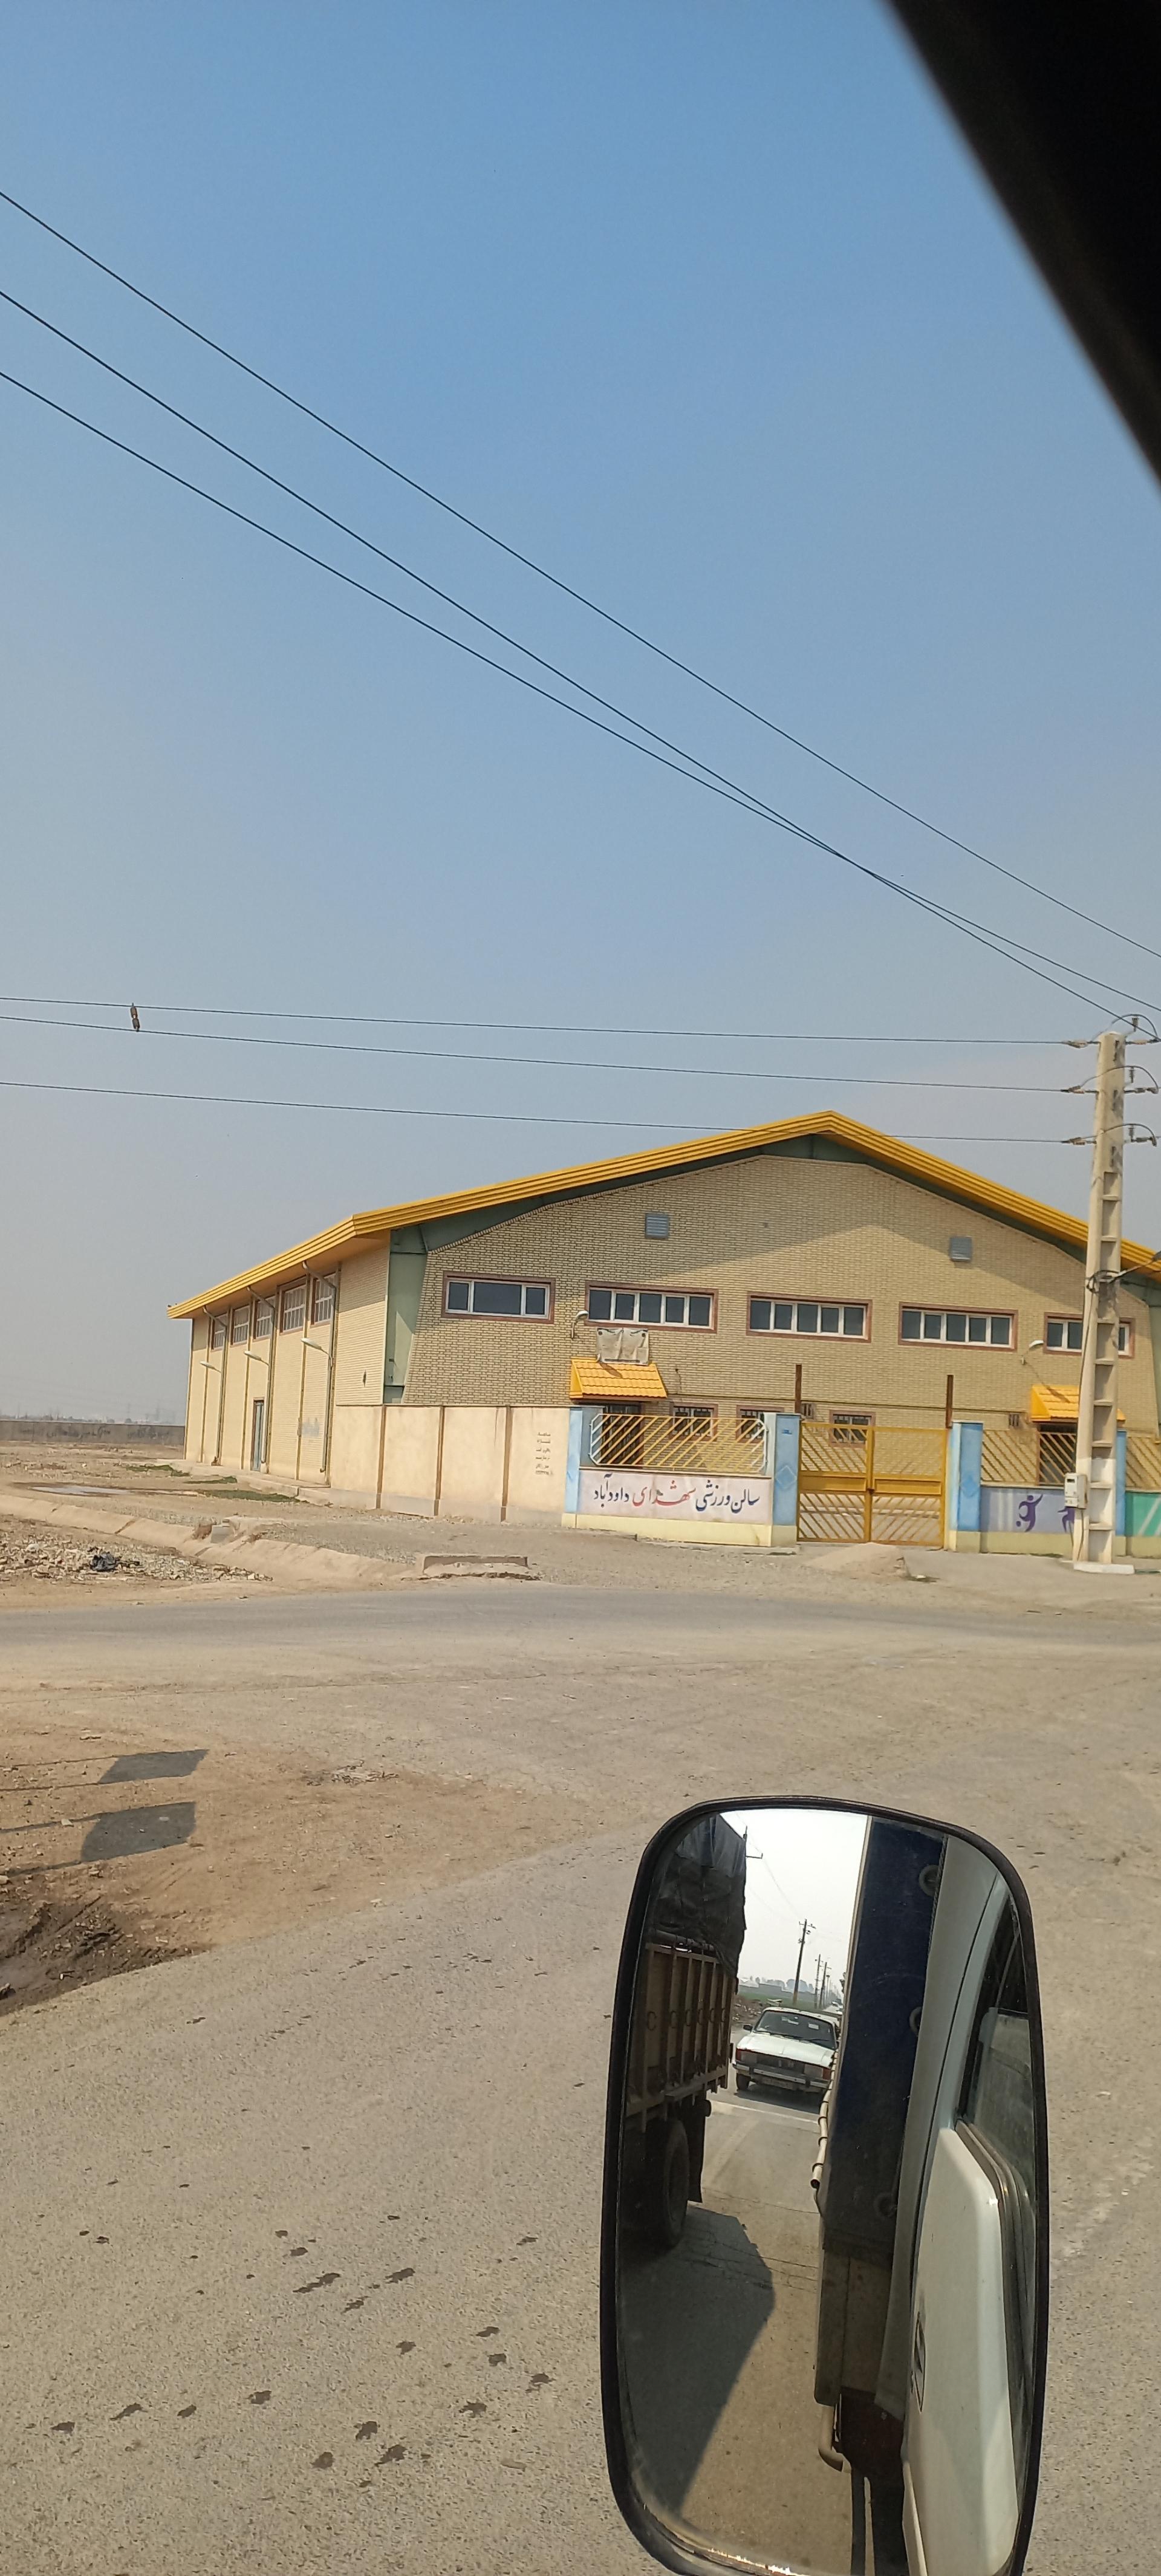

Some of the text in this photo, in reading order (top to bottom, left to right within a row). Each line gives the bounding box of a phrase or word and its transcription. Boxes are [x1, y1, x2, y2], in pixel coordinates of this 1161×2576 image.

[633, 1480, 696, 1507] شهدای
[695, 1480, 730, 1512] ورزشی
[730, 1488, 760, 1514] سالن
